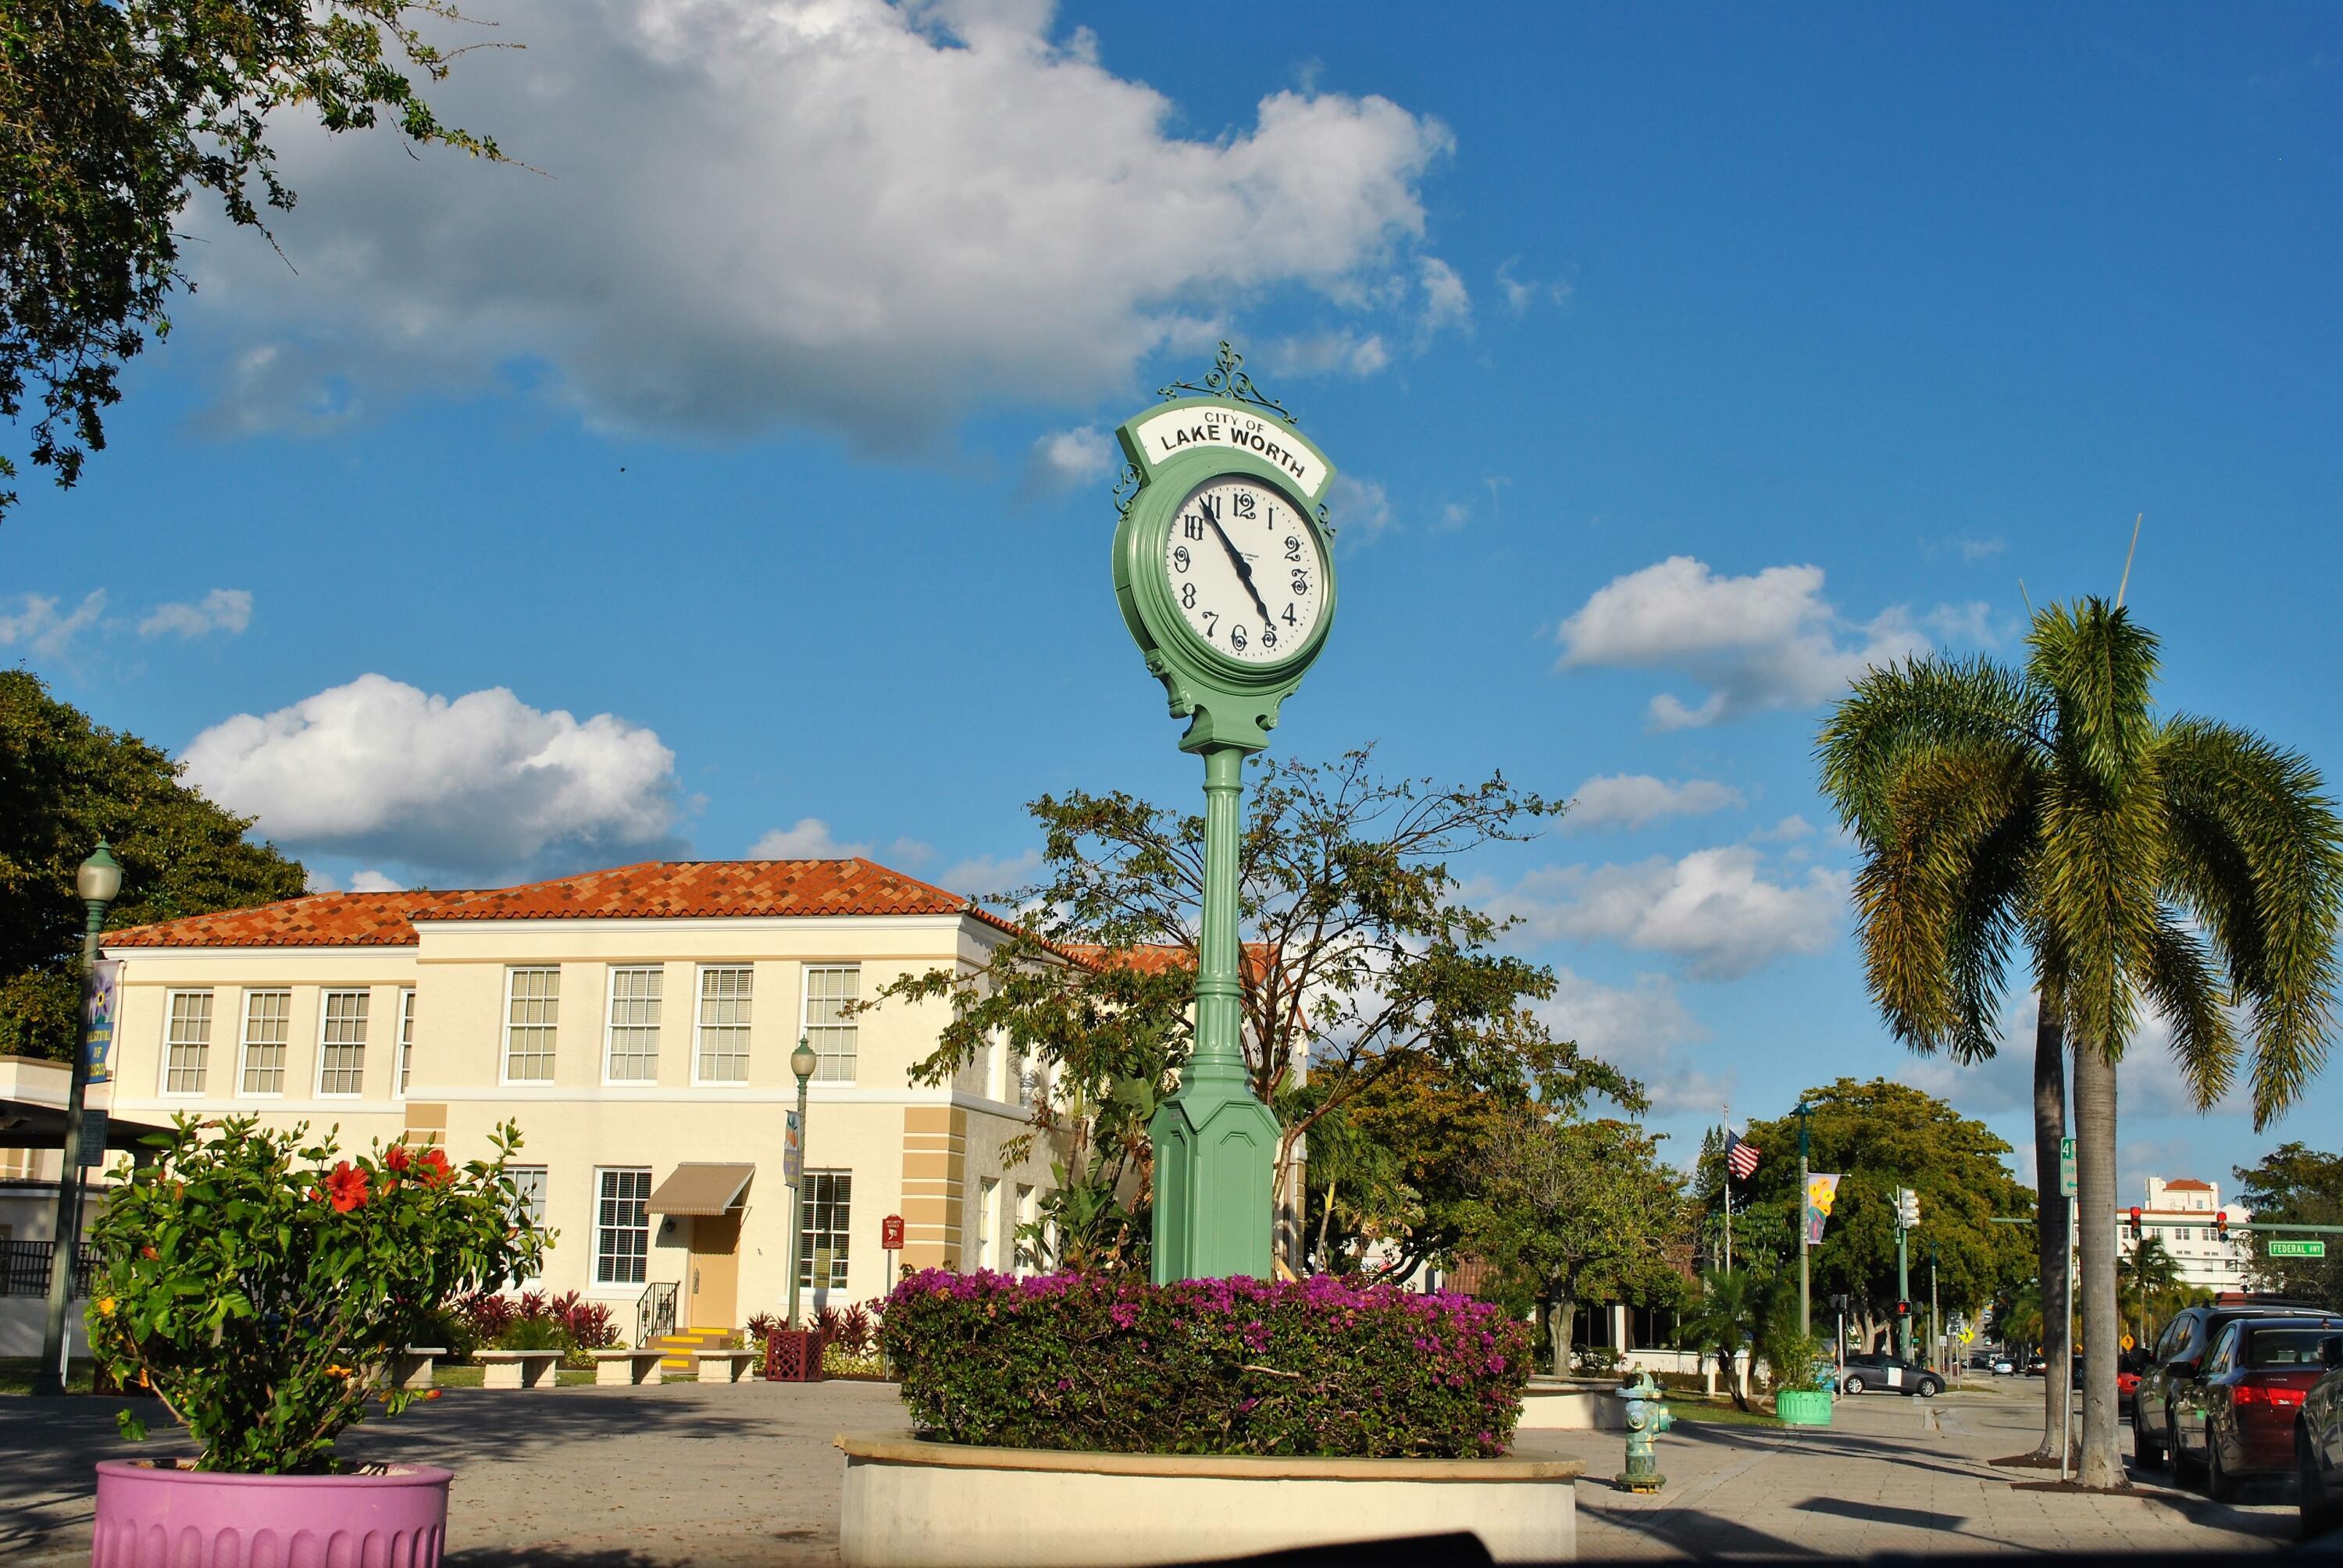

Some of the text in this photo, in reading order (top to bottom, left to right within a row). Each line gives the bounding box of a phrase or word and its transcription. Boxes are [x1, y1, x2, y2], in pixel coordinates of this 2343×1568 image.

[1204, 412, 1265, 433] CITY OF
[1161, 424, 1306, 479] LAKE WORTH
[1233, 493, 1257, 520] 12
[1268, 507, 1275, 531] 1
[1183, 513, 1204, 541] 10
[1173, 545, 1191, 574] 9
[1284, 536, 1301, 562] 2
[1181, 582, 1197, 609] 8
[1291, 568, 1309, 596] 3
[1201, 611, 1219, 638] 7
[1281, 602, 1297, 627] 4
[1231, 624, 1248, 651] 6
[1261, 622, 1278, 648] 5
[93, 1046, 102, 1059] OF
[2273, 1244, 2306, 1253] FEDERAL
